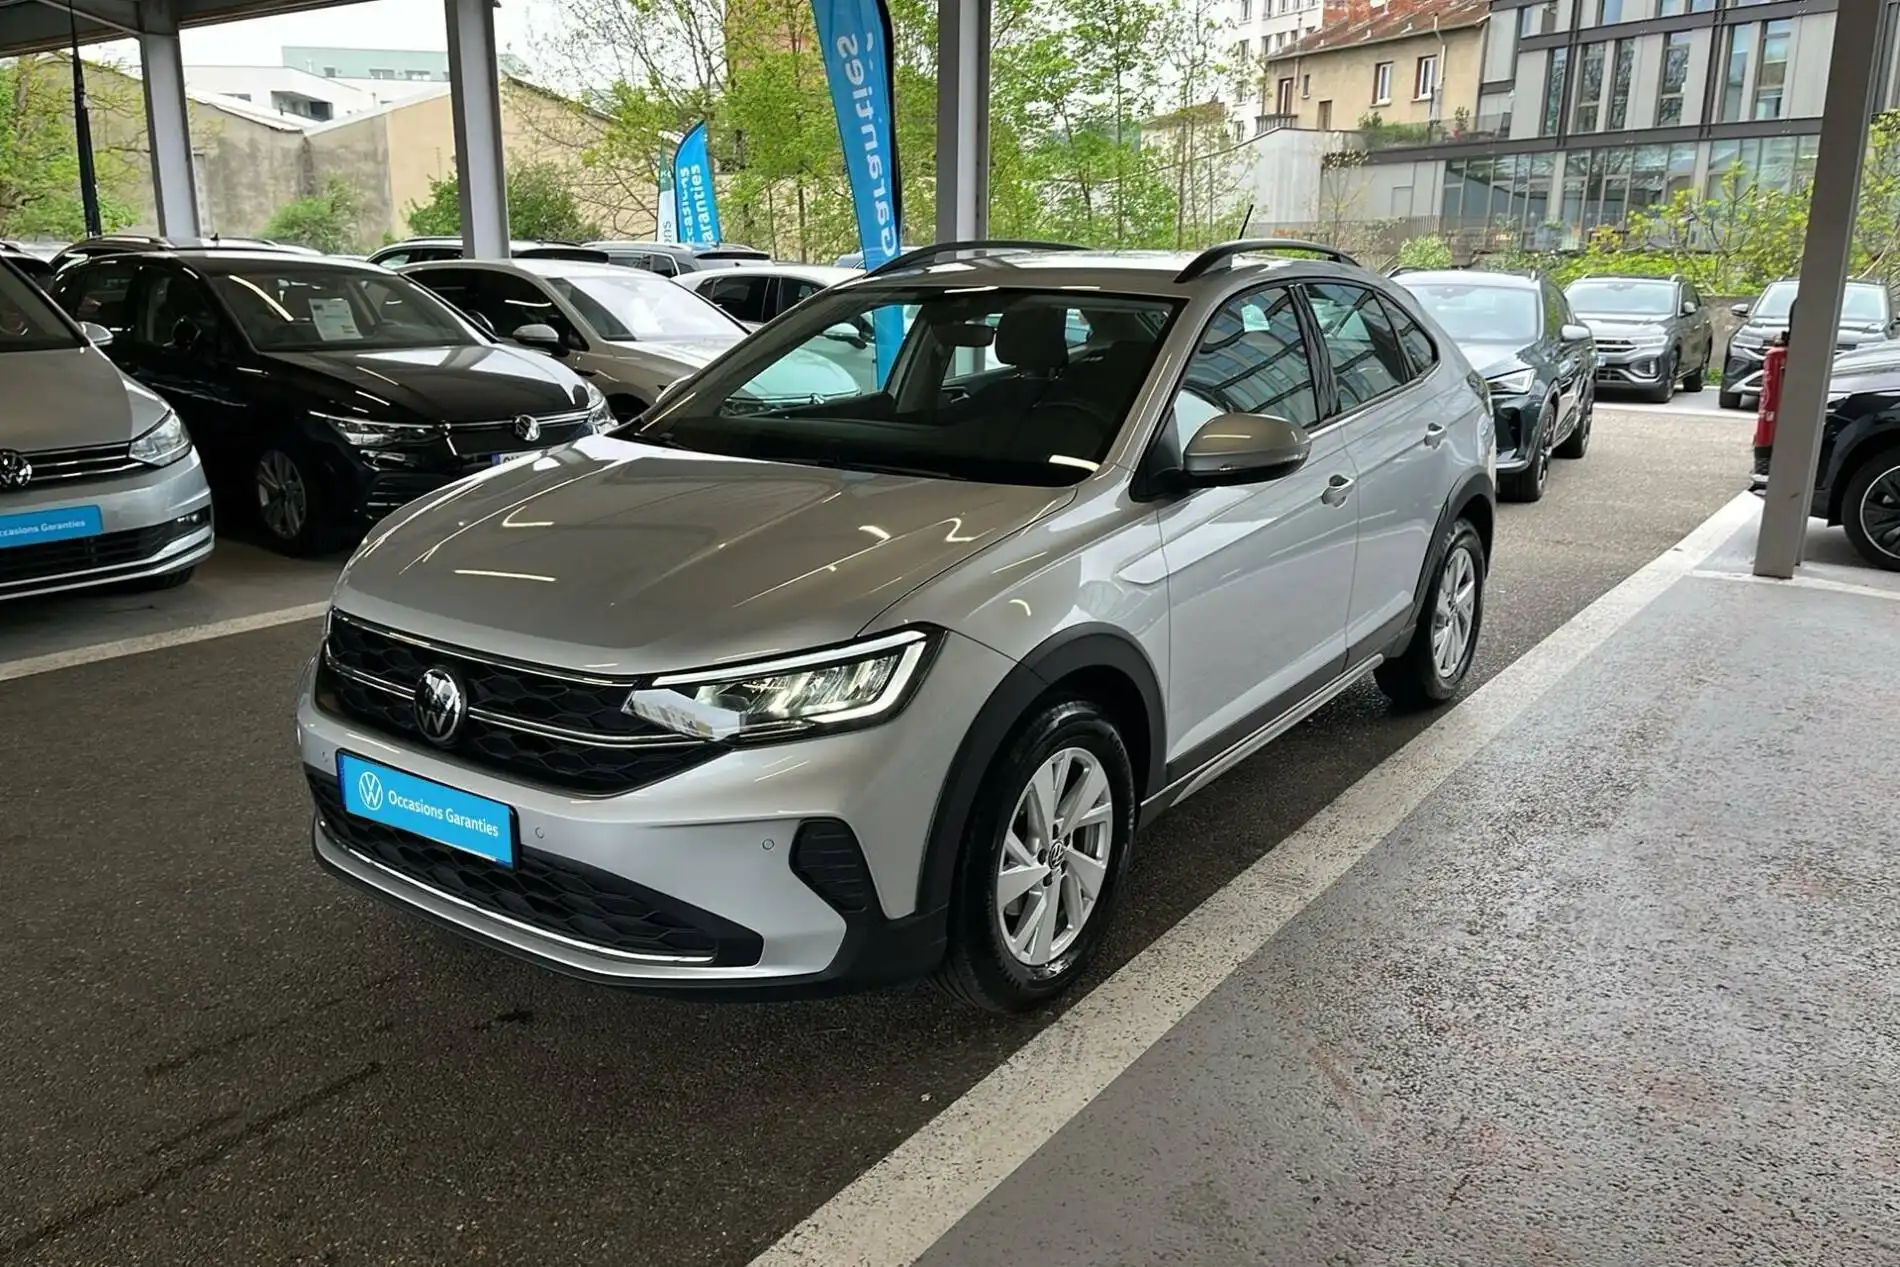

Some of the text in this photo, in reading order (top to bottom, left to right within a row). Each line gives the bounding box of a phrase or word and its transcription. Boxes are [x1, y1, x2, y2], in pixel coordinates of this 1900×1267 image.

[691, 164, 715, 247] aranties
[41, 520, 86, 532] Garanties
[388, 790, 443, 820] Occasions
[445, 808, 499, 838] Garanties
